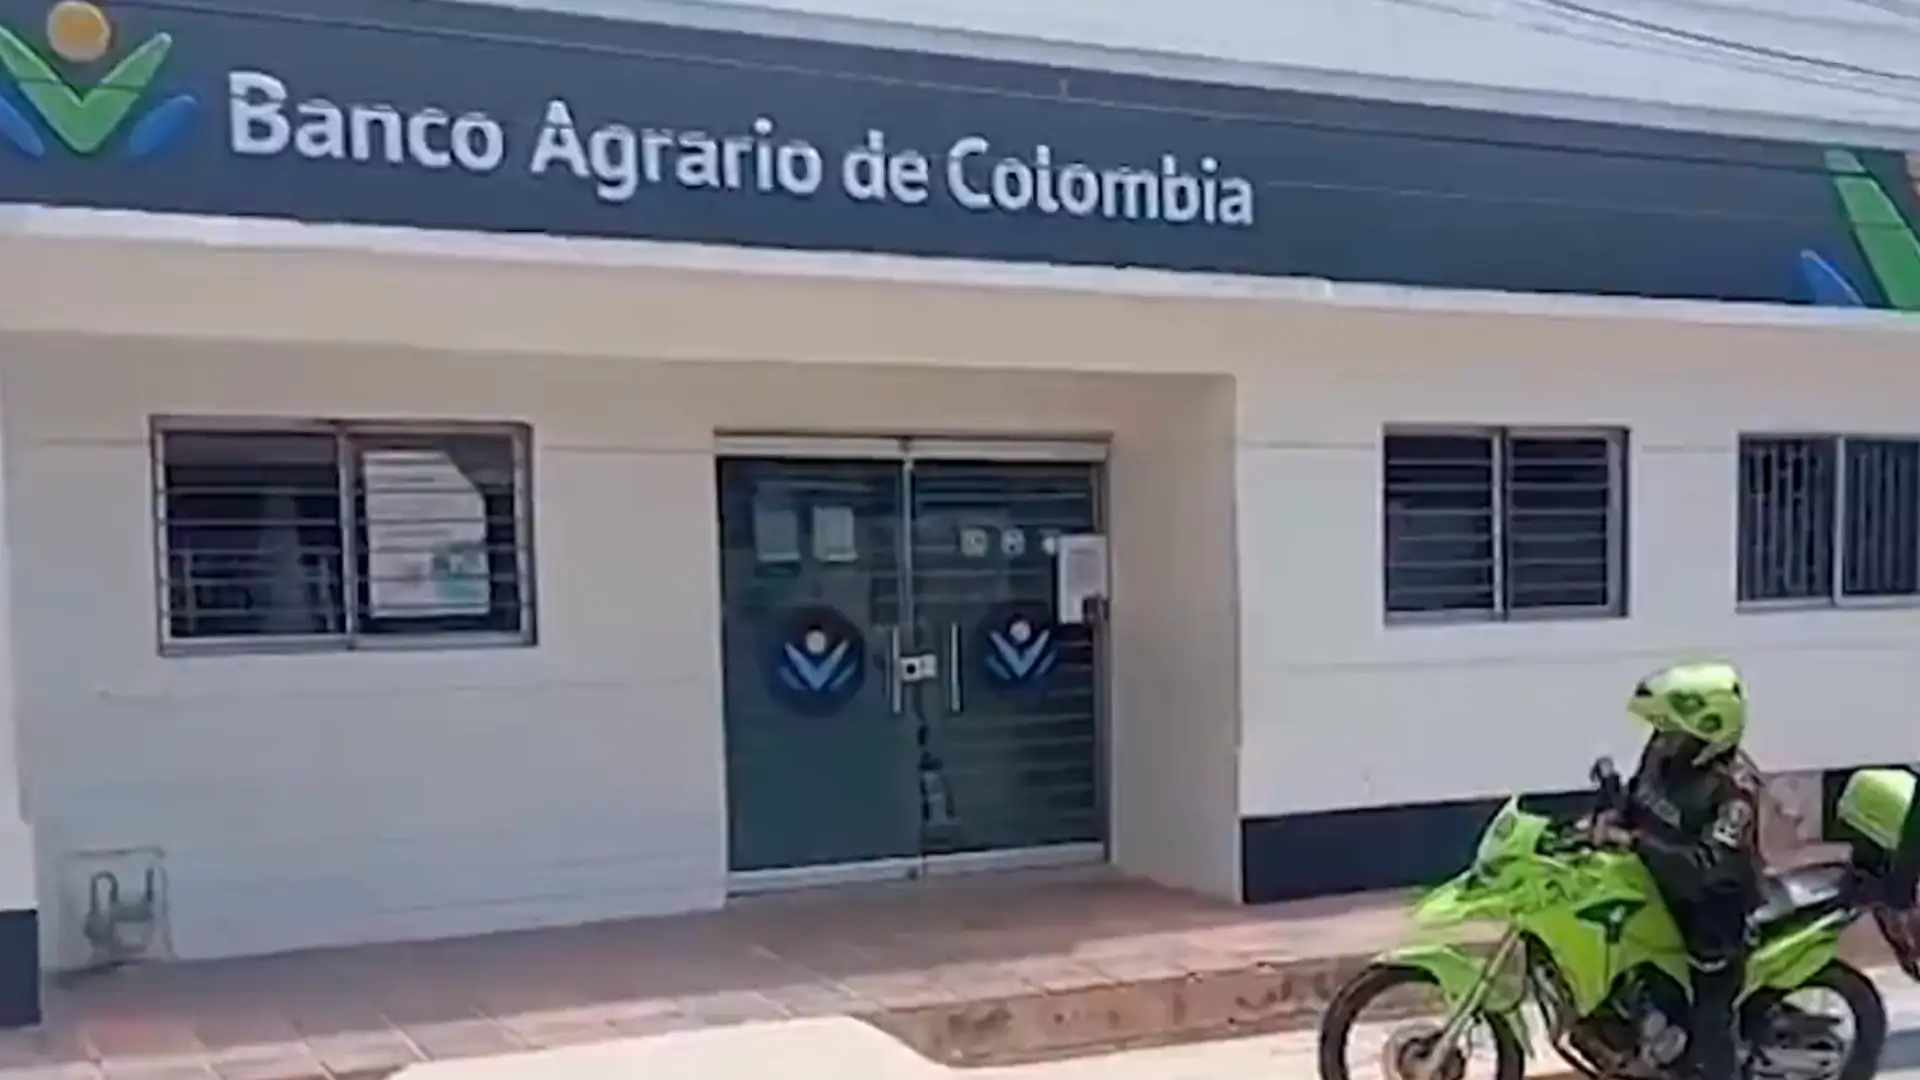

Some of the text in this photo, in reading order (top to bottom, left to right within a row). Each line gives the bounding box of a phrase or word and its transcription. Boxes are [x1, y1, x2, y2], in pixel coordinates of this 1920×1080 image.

[228, 71, 1255, 226] Banco Agrario de Colombia
